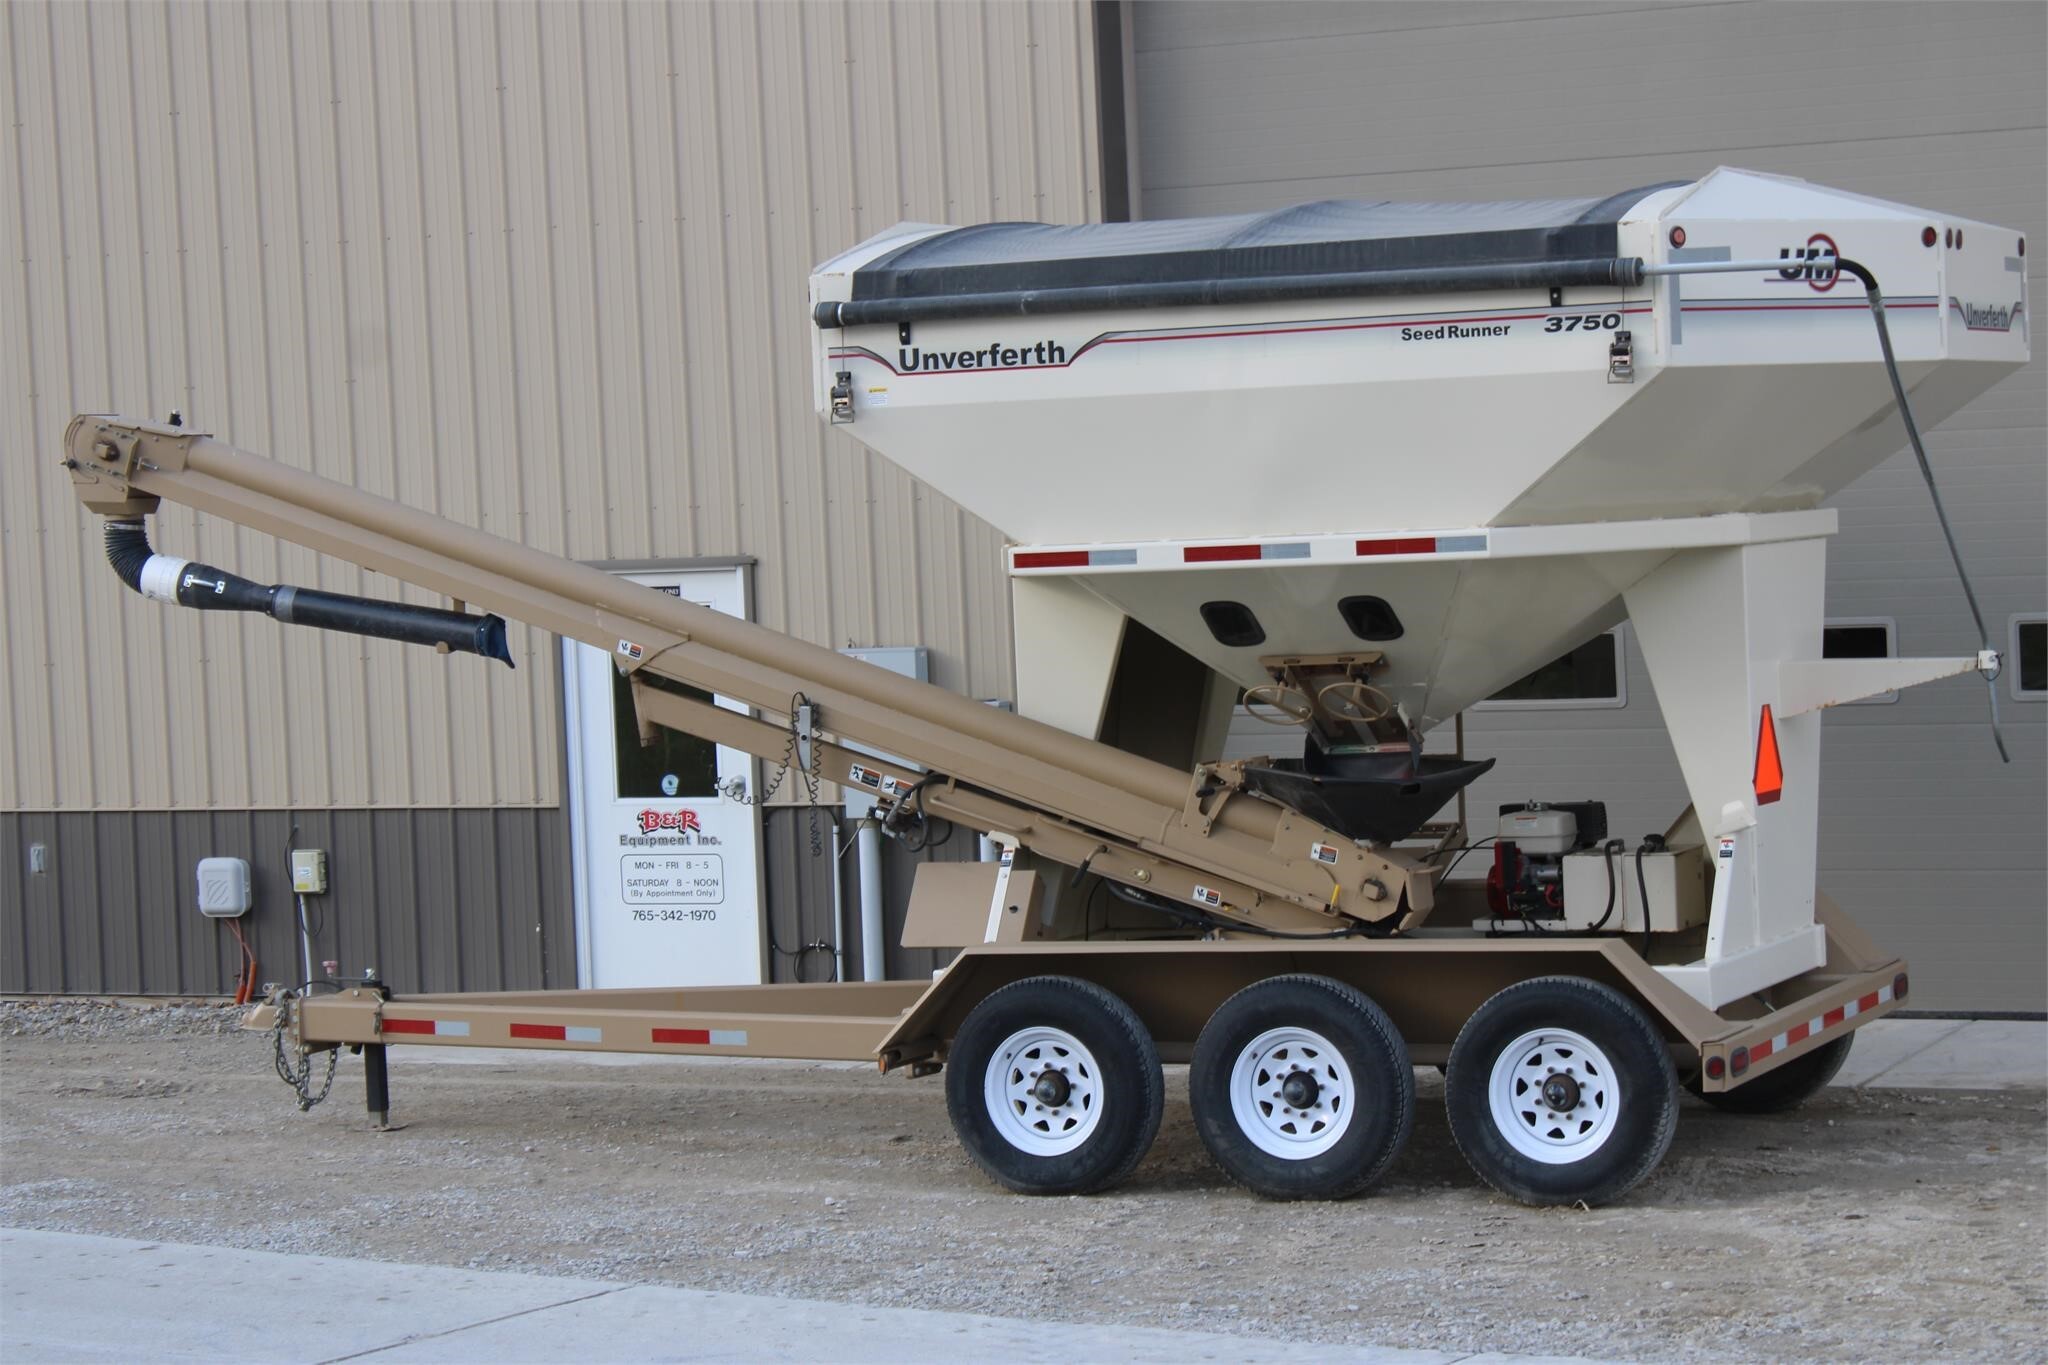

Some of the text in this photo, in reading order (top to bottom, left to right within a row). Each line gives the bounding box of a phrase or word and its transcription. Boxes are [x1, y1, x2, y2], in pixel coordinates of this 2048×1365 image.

[1966, 303, 2009, 328] Unverferth
[1544, 313, 1622, 333] 3750
[899, 340, 1065, 372] Unverferth
[637, 809, 701, 835] B&R
[619, 834, 722, 847] Equipment Inc.
[634, 861, 655, 870] MON
[665, 861, 679, 870] FRI
[686, 861, 692, 870] 8
[703, 861, 709, 869] 5
[626, 878, 669, 887] SATURDAY
[676, 878, 682, 887] 8
[693, 878, 719, 887] NOON
[630, 889, 716, 898] (By Appointment Only)
[632, 910, 716, 921] 765-342-1970
